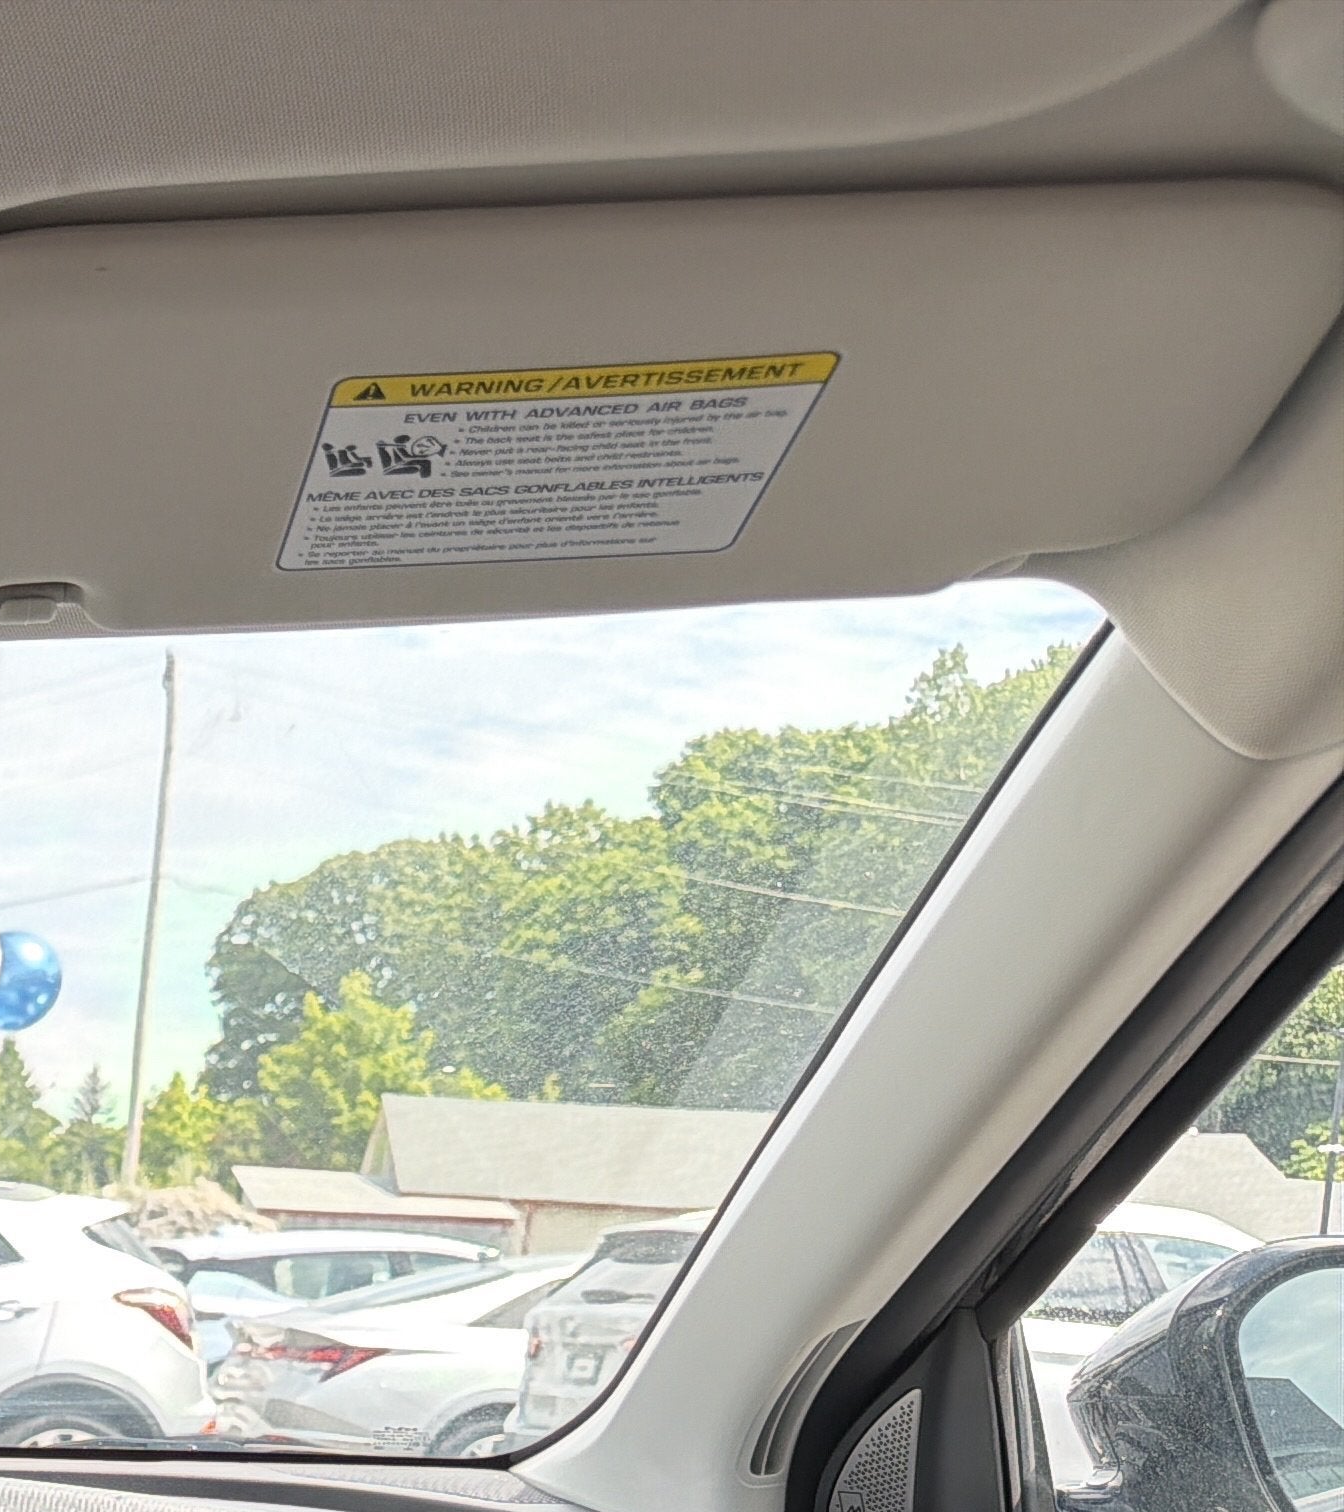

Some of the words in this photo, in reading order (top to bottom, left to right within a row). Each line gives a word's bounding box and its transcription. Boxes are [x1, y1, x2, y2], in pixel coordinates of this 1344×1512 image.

[405, 412, 457, 425] EVEN
[466, 409, 518, 422] WITH
[524, 403, 639, 419] ADVANCED
[647, 401, 682, 413] AIR
[690, 396, 748, 410] BAGS
[307, 491, 360, 503] MÊME
[364, 489, 414, 501] AVEC
[418, 487, 456, 499] DES
[459, 484, 510, 497] SACS
[514, 478, 635, 495] GONFLABLES
[637, 472, 765, 489] INTELLIGENTS
